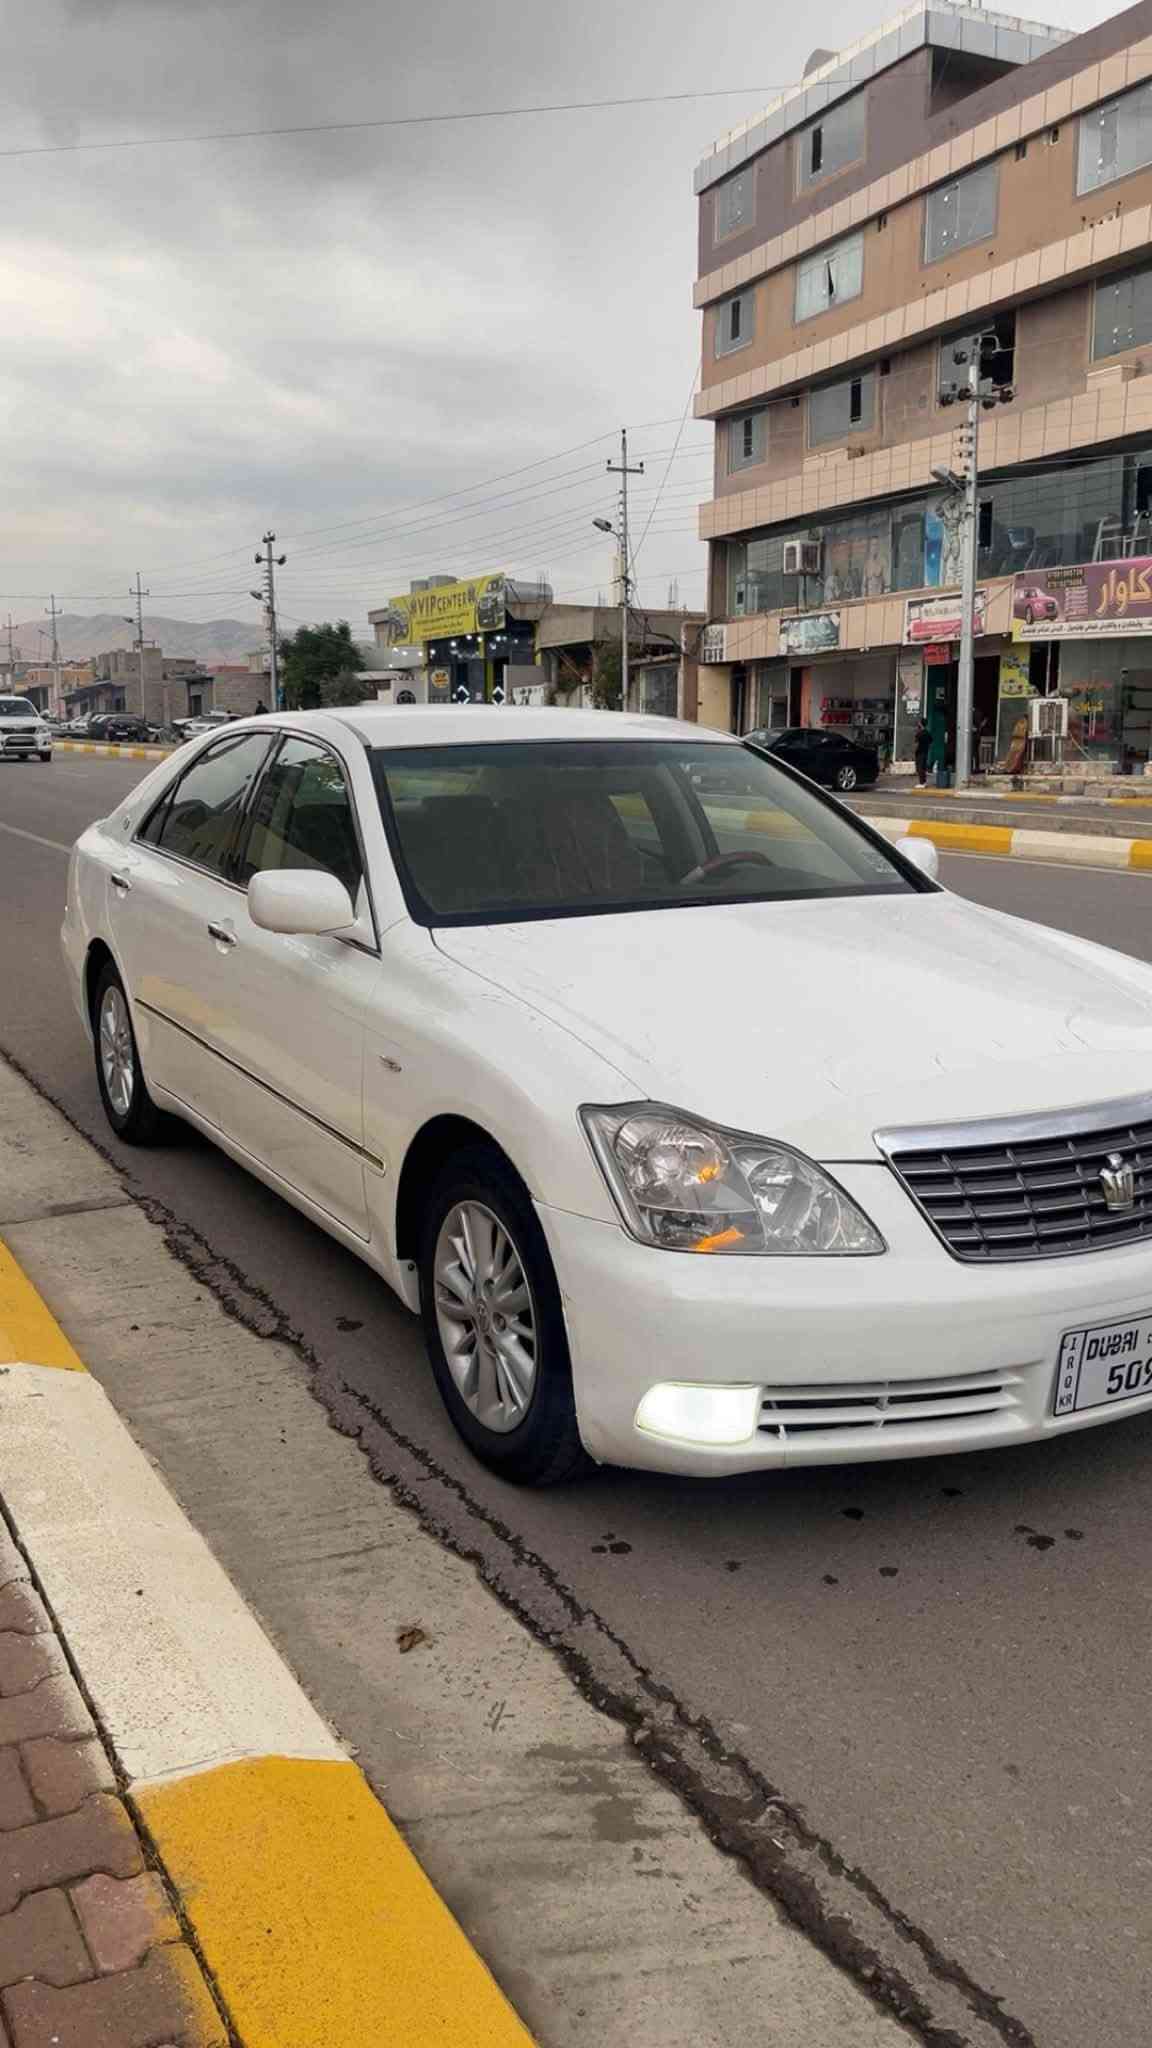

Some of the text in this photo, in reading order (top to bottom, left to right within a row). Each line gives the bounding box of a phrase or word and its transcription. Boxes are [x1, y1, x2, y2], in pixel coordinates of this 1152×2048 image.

[416, 595, 437, 617] VIP
[437, 591, 469, 612] CENTER
[1086, 1329, 1139, 1361] DUBAI
[1058, 1393, 1073, 1408] KR
